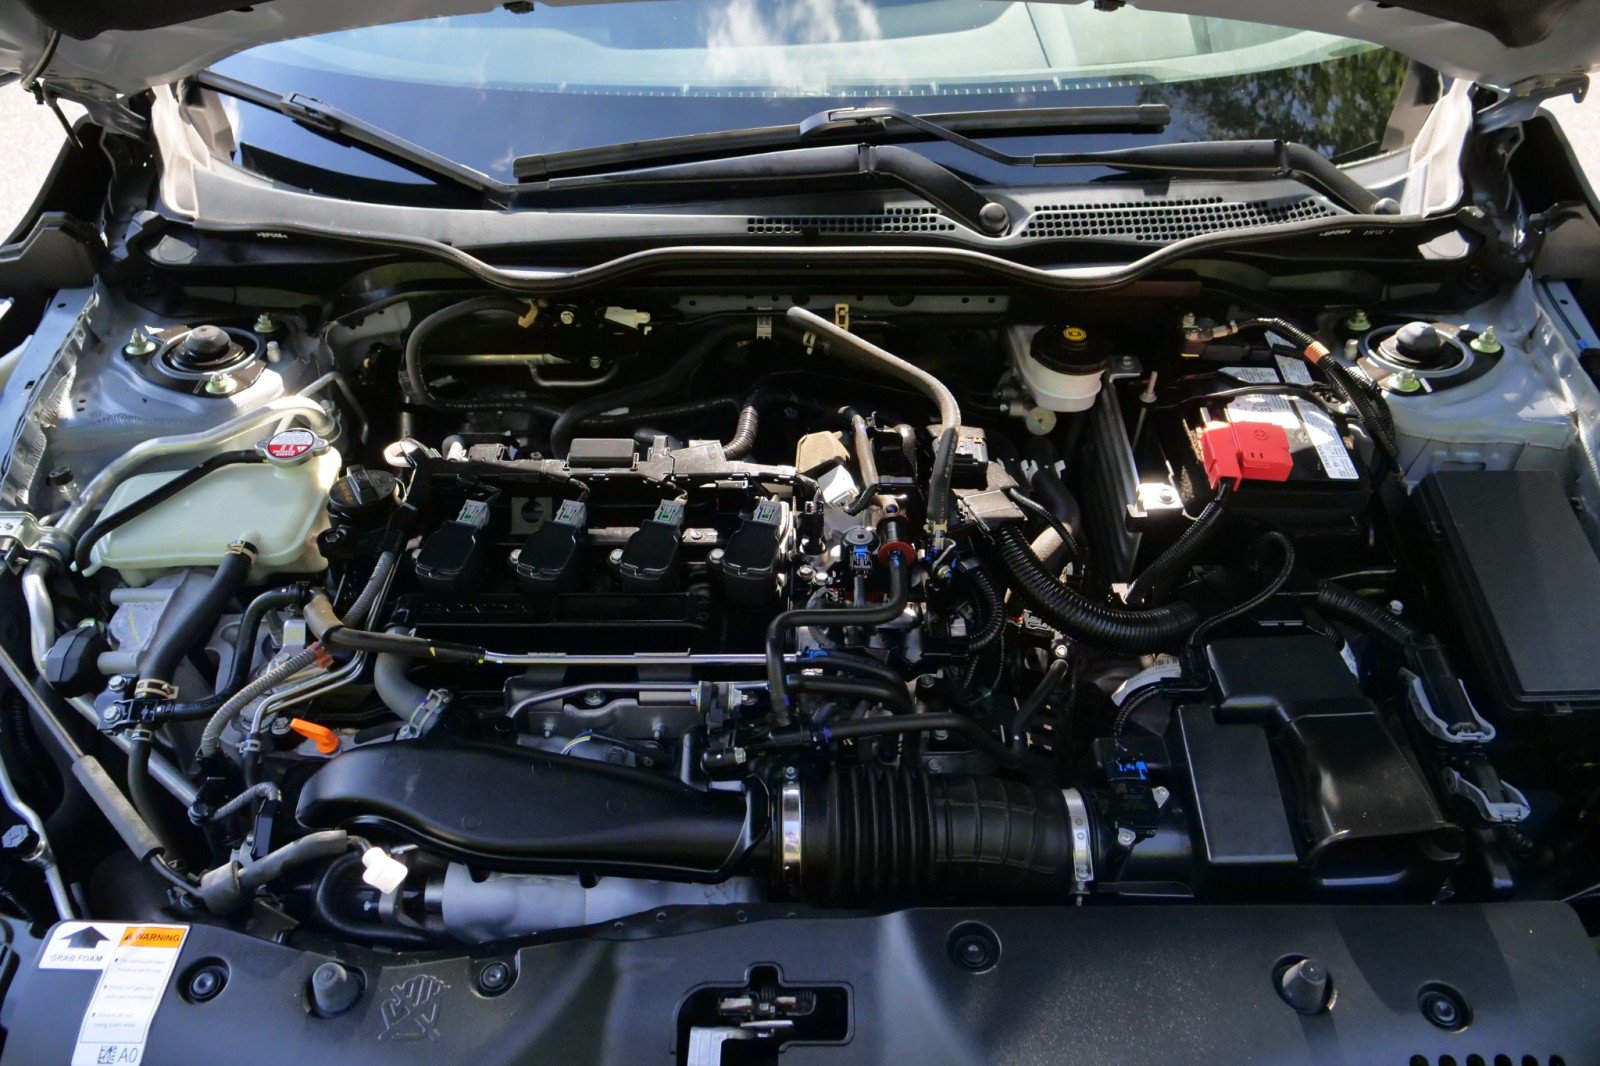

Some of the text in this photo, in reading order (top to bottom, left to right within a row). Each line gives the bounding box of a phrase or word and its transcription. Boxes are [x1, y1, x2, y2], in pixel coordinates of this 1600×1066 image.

[136, 932, 180, 942] WARNING
[50, 954, 103, 963] GRAB FOAM
[117, 1047, 139, 1064] A0
